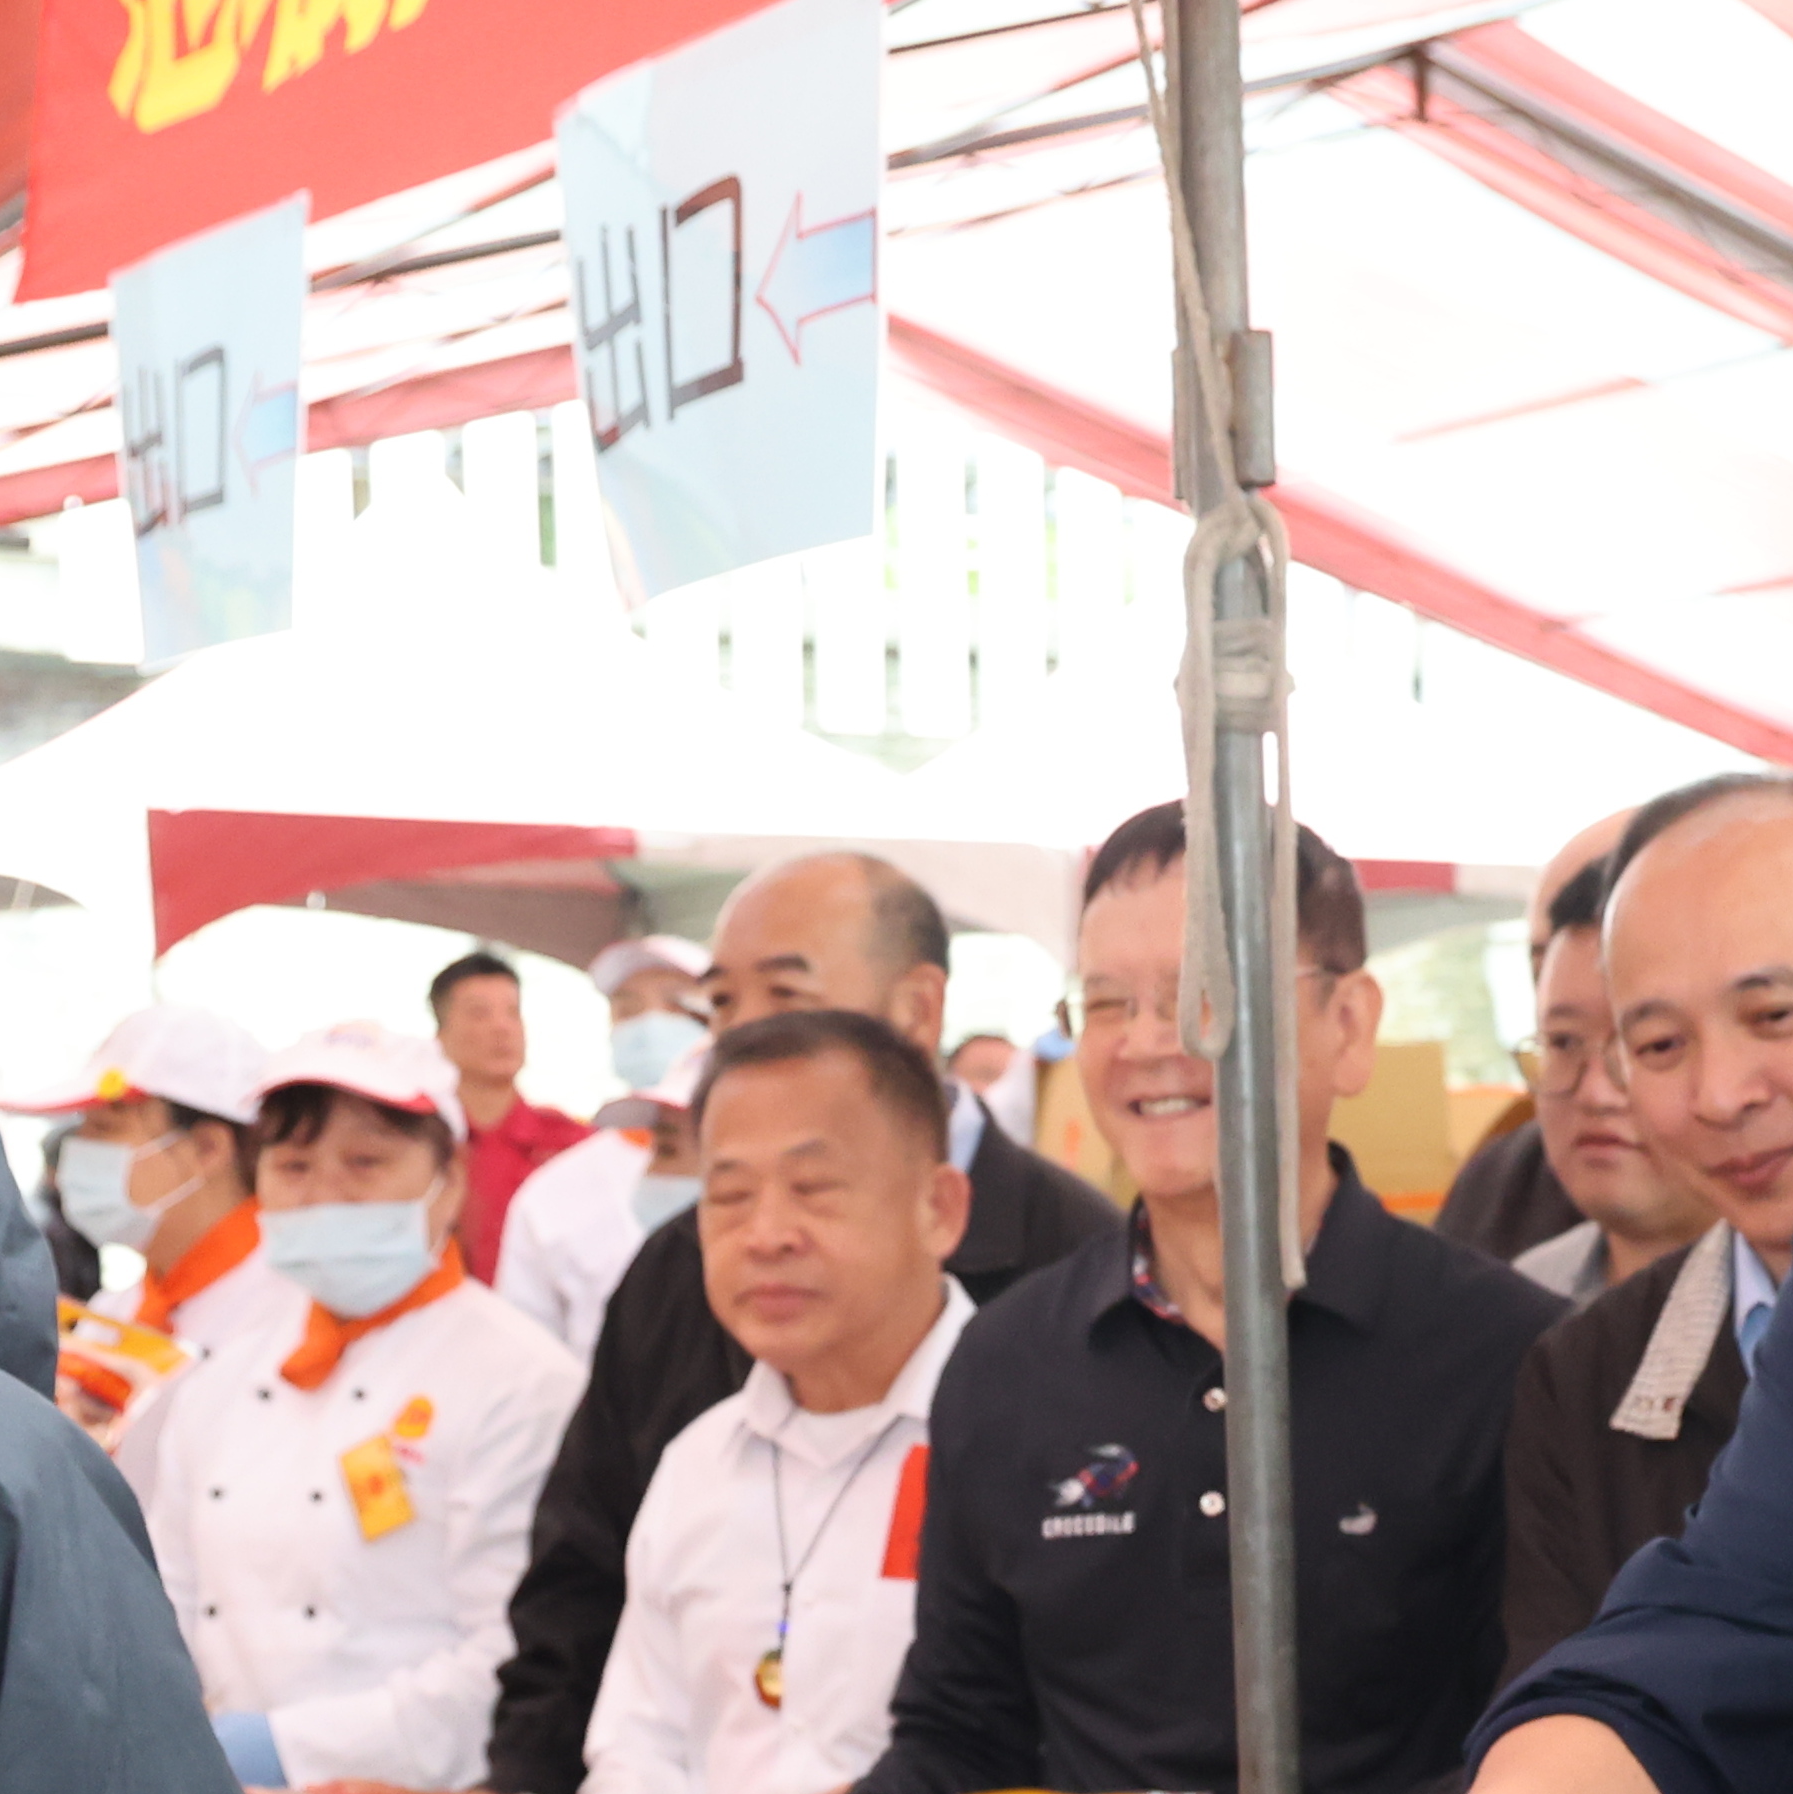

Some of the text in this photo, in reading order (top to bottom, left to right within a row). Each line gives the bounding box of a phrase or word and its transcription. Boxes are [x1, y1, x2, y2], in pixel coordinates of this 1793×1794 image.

[575, 174, 745, 454] 出口
[123, 346, 227, 540] 出口
[1041, 1511, 1137, 1539] CROCODILE
